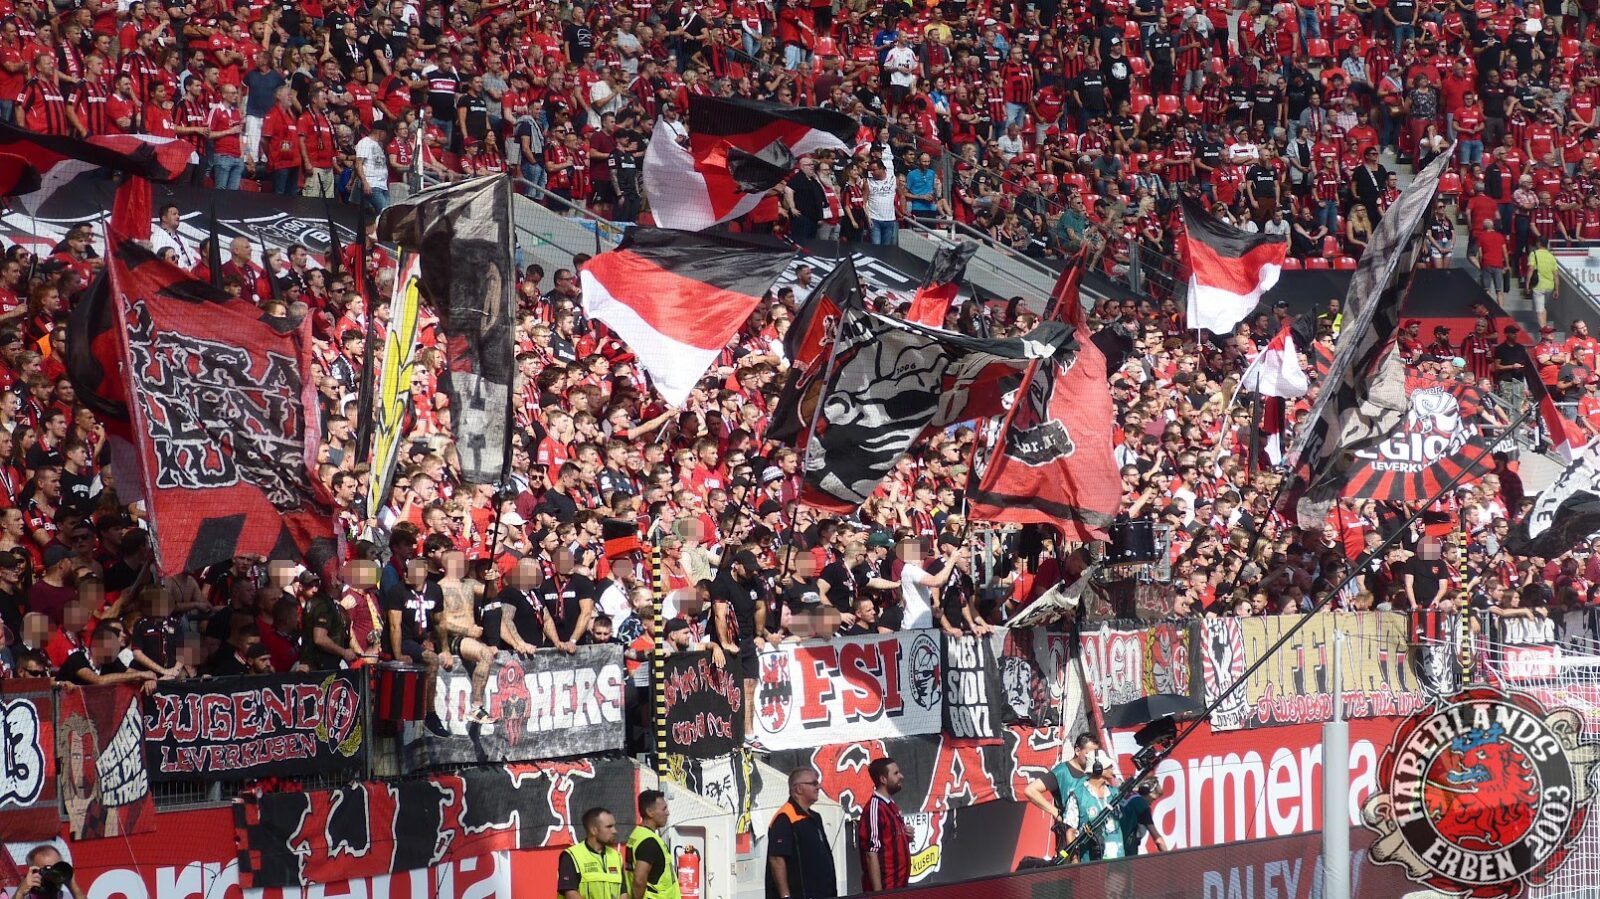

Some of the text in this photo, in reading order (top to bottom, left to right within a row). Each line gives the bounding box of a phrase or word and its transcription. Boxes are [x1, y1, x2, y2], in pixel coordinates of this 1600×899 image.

[794, 638, 903, 730] FSI
[145, 683, 325, 743] JUGEND
[948, 705, 995, 738] BOYZ
[160, 733, 318, 774] LEVERKUSEN
[1108, 729, 1379, 852] armena
[903, 813, 927, 826] AYER
[911, 852, 936, 873] kusen
